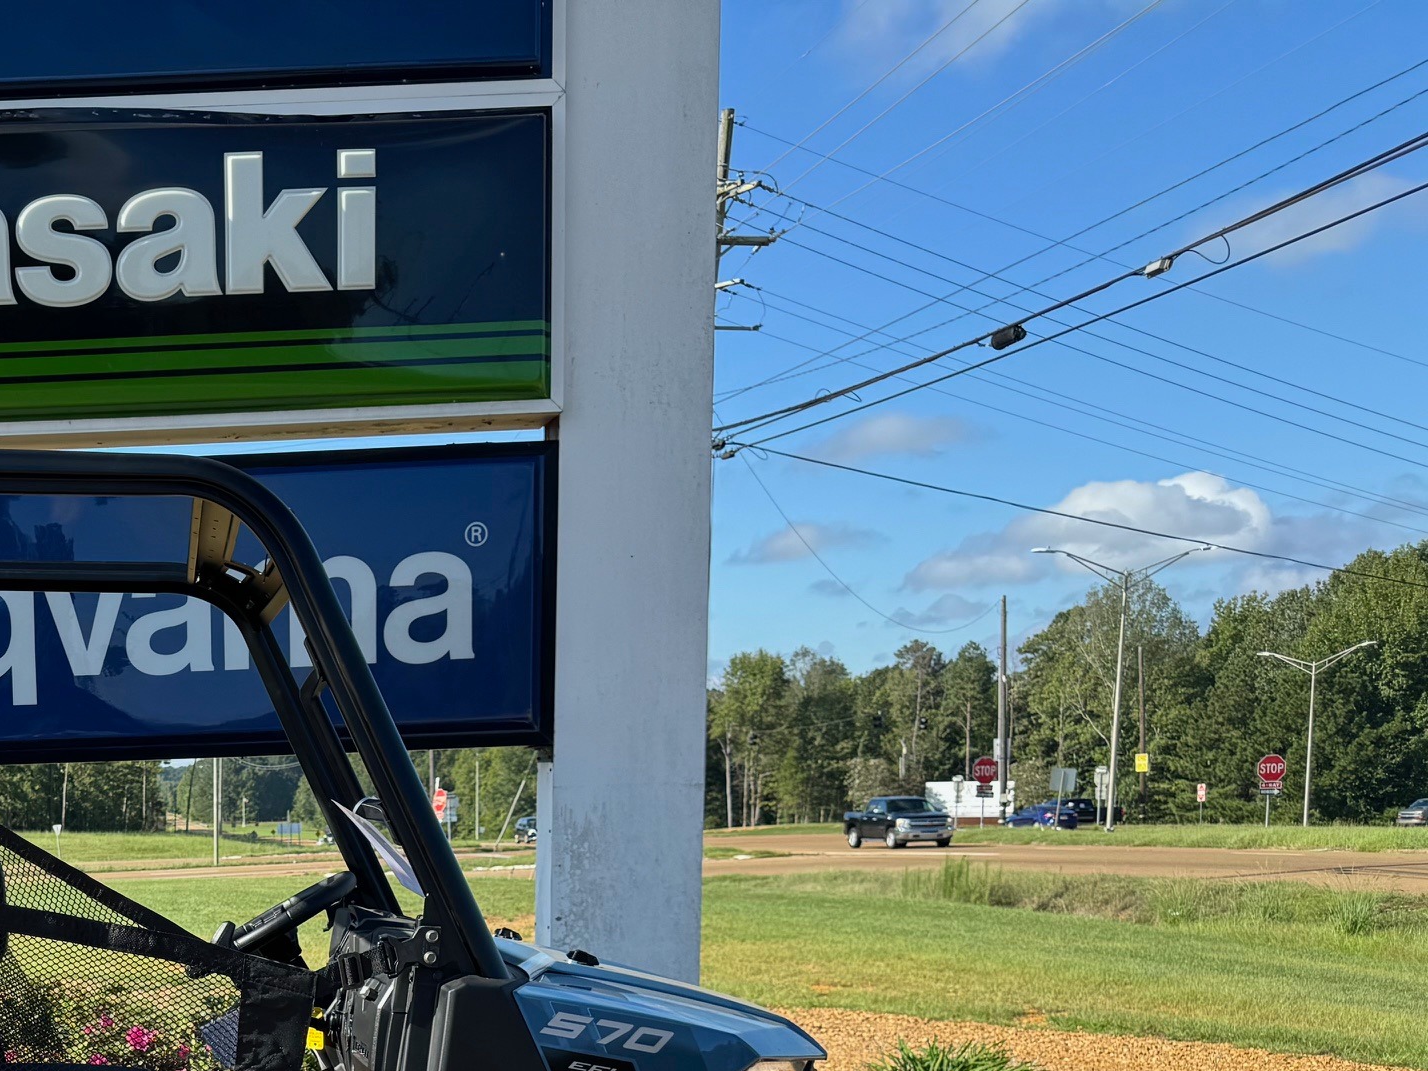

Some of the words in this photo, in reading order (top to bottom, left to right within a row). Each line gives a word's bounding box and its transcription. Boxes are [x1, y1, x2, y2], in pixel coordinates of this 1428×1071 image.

[974, 765, 996, 776] STOP
[1259, 762, 1284, 774] STOP
[539, 1011, 674, 1054] 570
